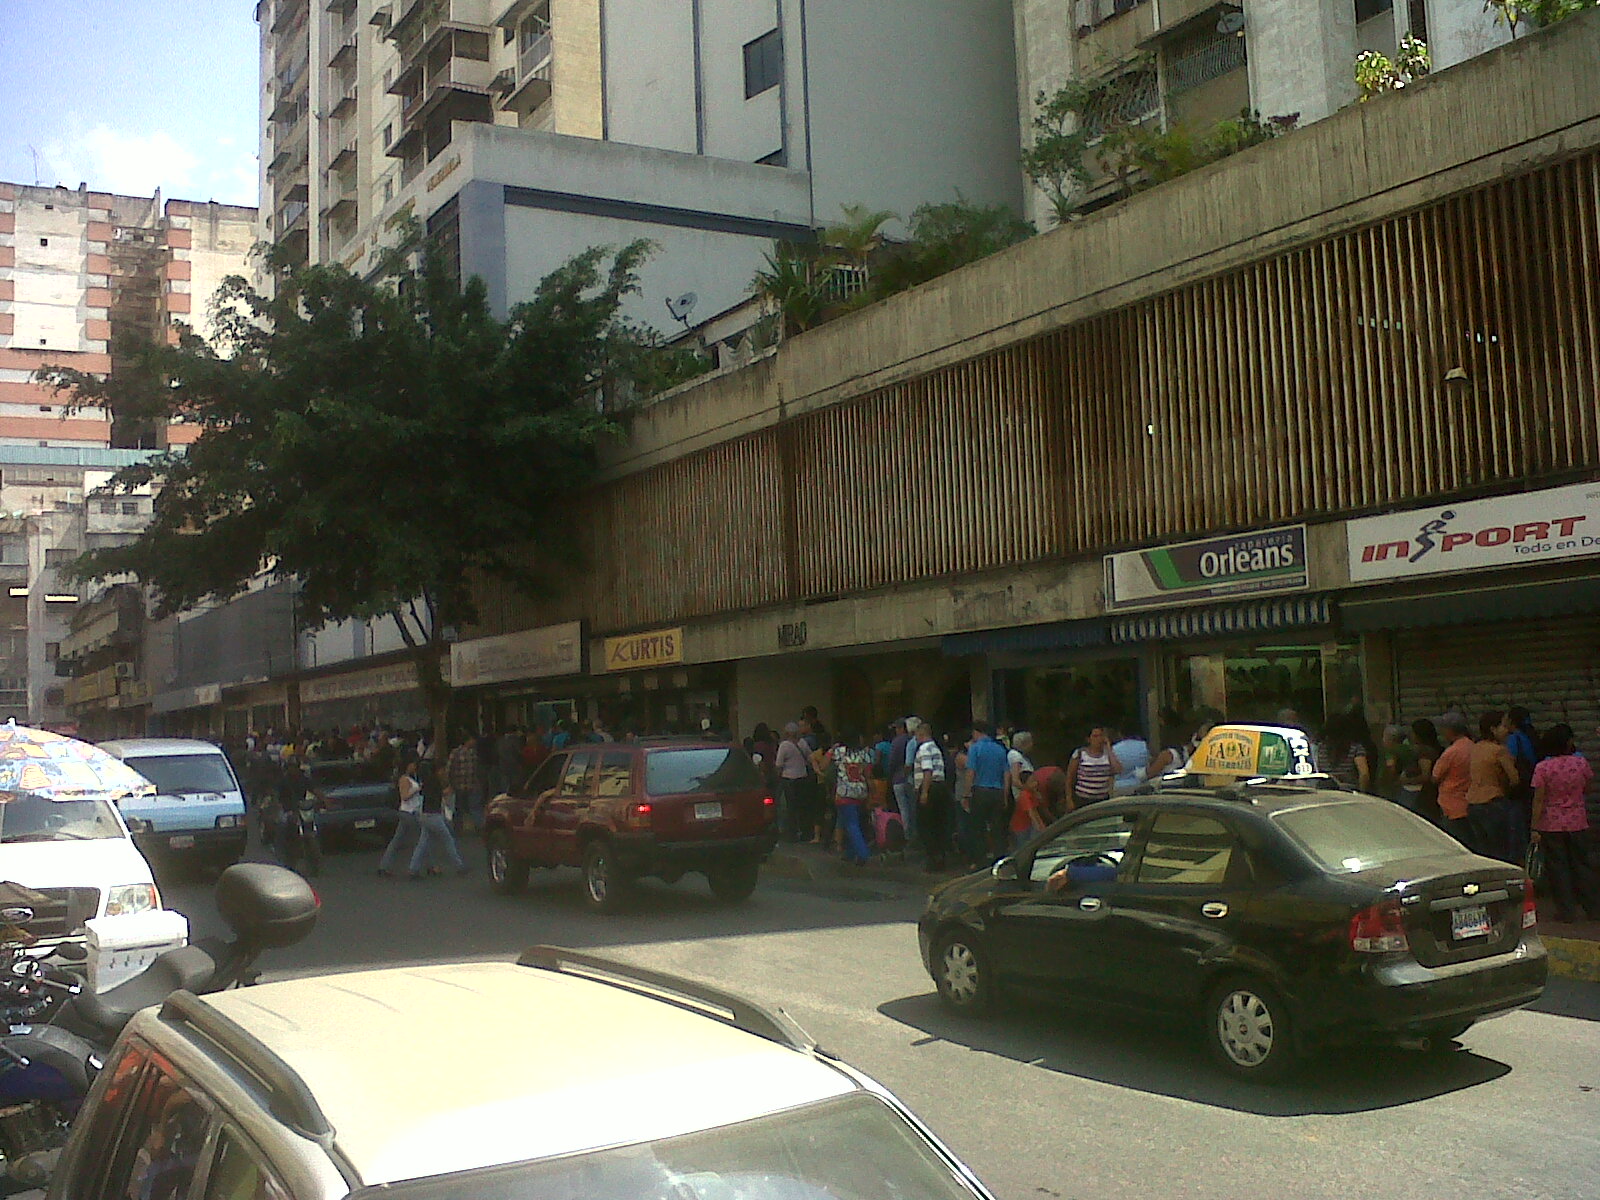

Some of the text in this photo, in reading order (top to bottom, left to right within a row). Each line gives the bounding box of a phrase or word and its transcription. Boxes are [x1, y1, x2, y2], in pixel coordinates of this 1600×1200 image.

[1200, 543, 1295, 578] Orleans
[1514, 543, 1551, 555] Todo
[1556, 540, 1577, 550] en
[611, 635, 675, 662] KURTIS
